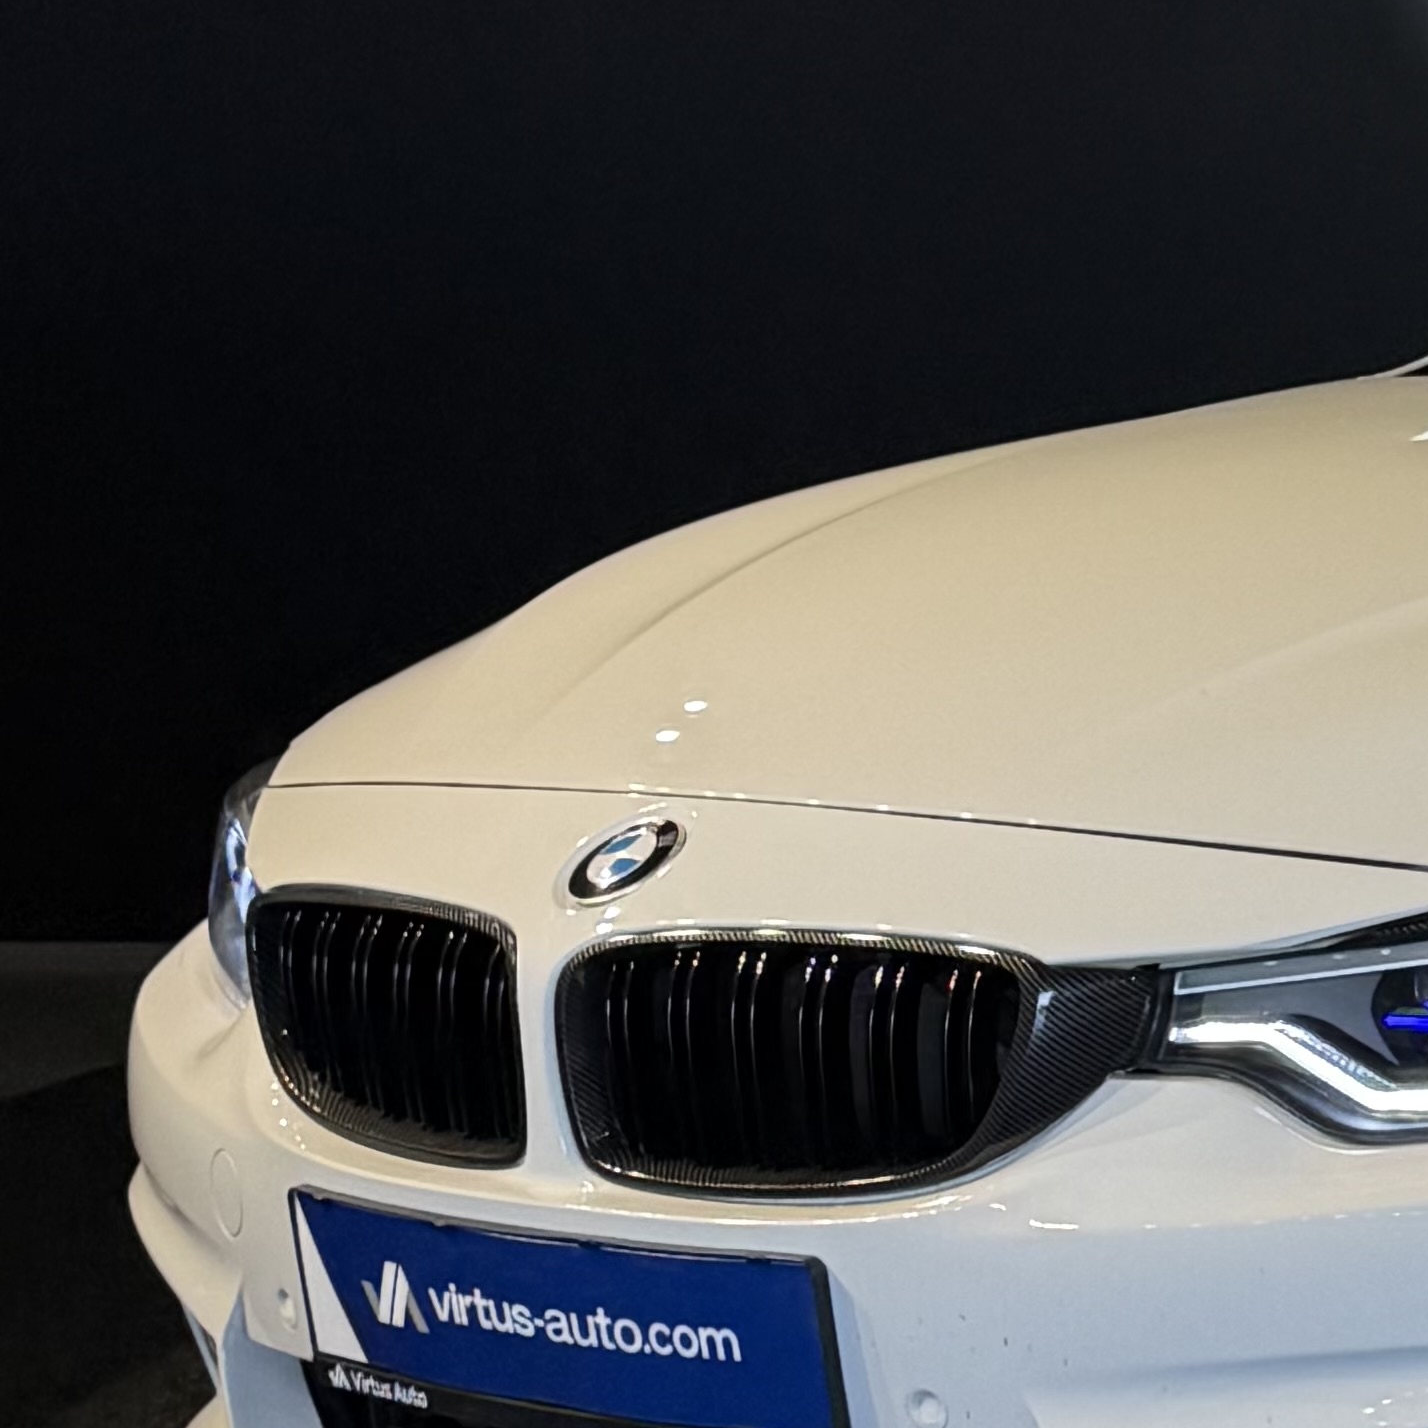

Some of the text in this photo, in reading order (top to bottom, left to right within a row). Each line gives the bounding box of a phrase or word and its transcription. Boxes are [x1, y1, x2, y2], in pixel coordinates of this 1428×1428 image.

[428, 1283, 742, 1362] virtus-auto.com
[350, 1369, 392, 1401] Virtus
[394, 1381, 428, 1409] Auto
